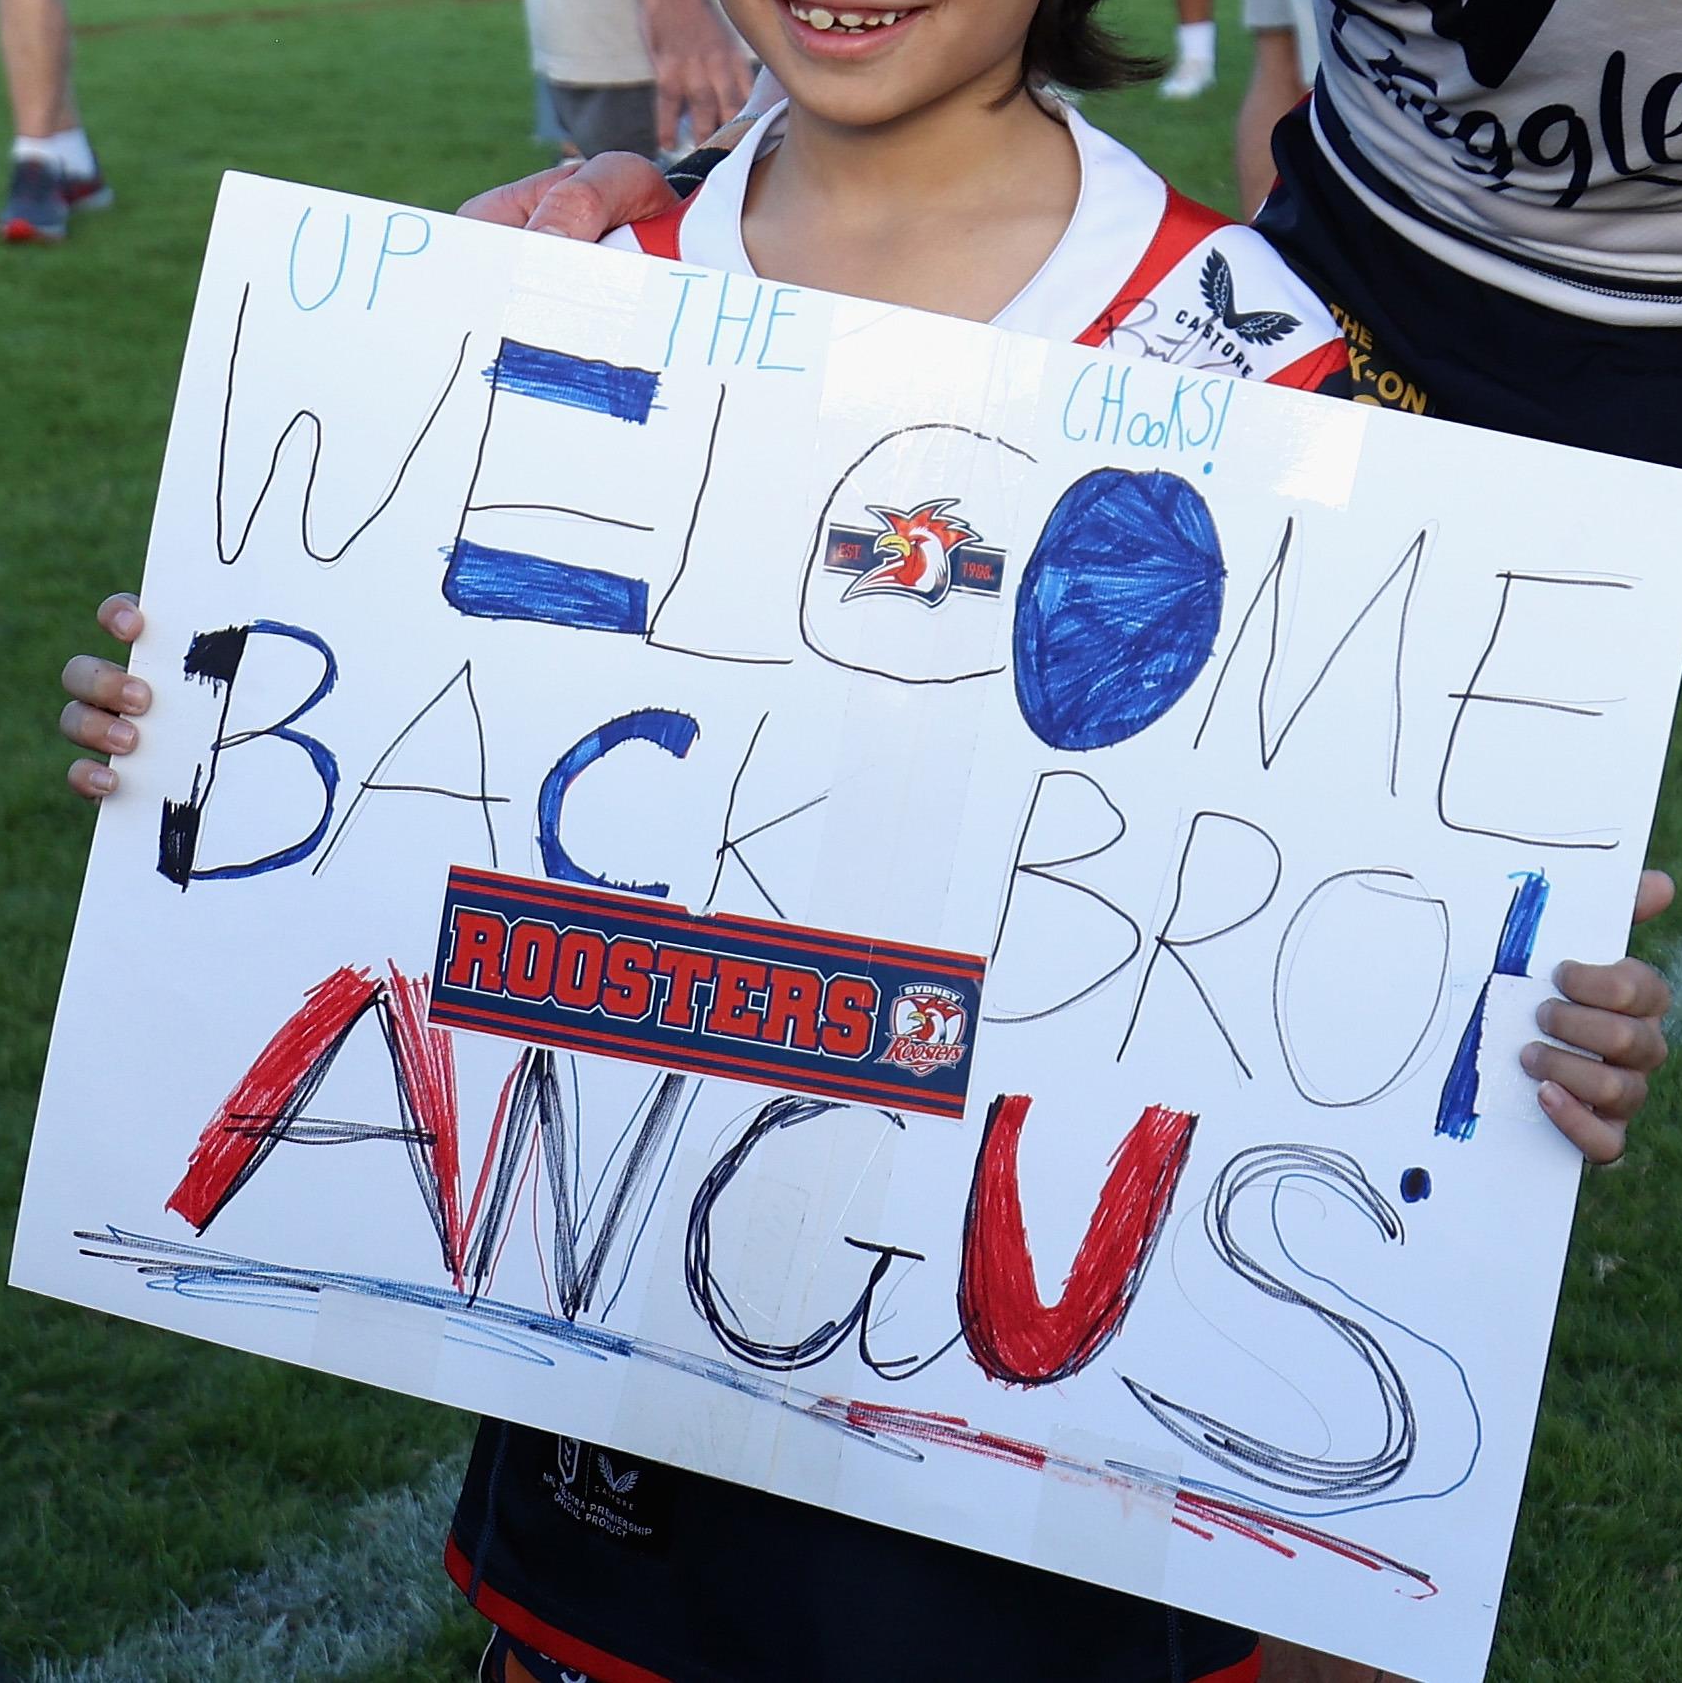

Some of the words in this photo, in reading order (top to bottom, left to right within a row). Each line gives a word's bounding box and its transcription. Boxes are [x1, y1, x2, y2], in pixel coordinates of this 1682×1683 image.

[288, 205, 432, 312] UP
[668, 271, 807, 373] THE
[1175, 309, 1254, 379] CASTORE
[1330, 303, 1374, 350] THE
[1348, 346, 1428, 416] K-ON
[216, 280, 1639, 851] WELCOME
[155, 617, 829, 920] BACK
[981, 768, 1551, 1204] BRO!
[443, 903, 881, 1062] ROOSTERS
[904, 985, 961, 1003] SYDNEY
[879, 1034, 966, 1064] Roosters
[163, 960, 1467, 1508] ANGUS
